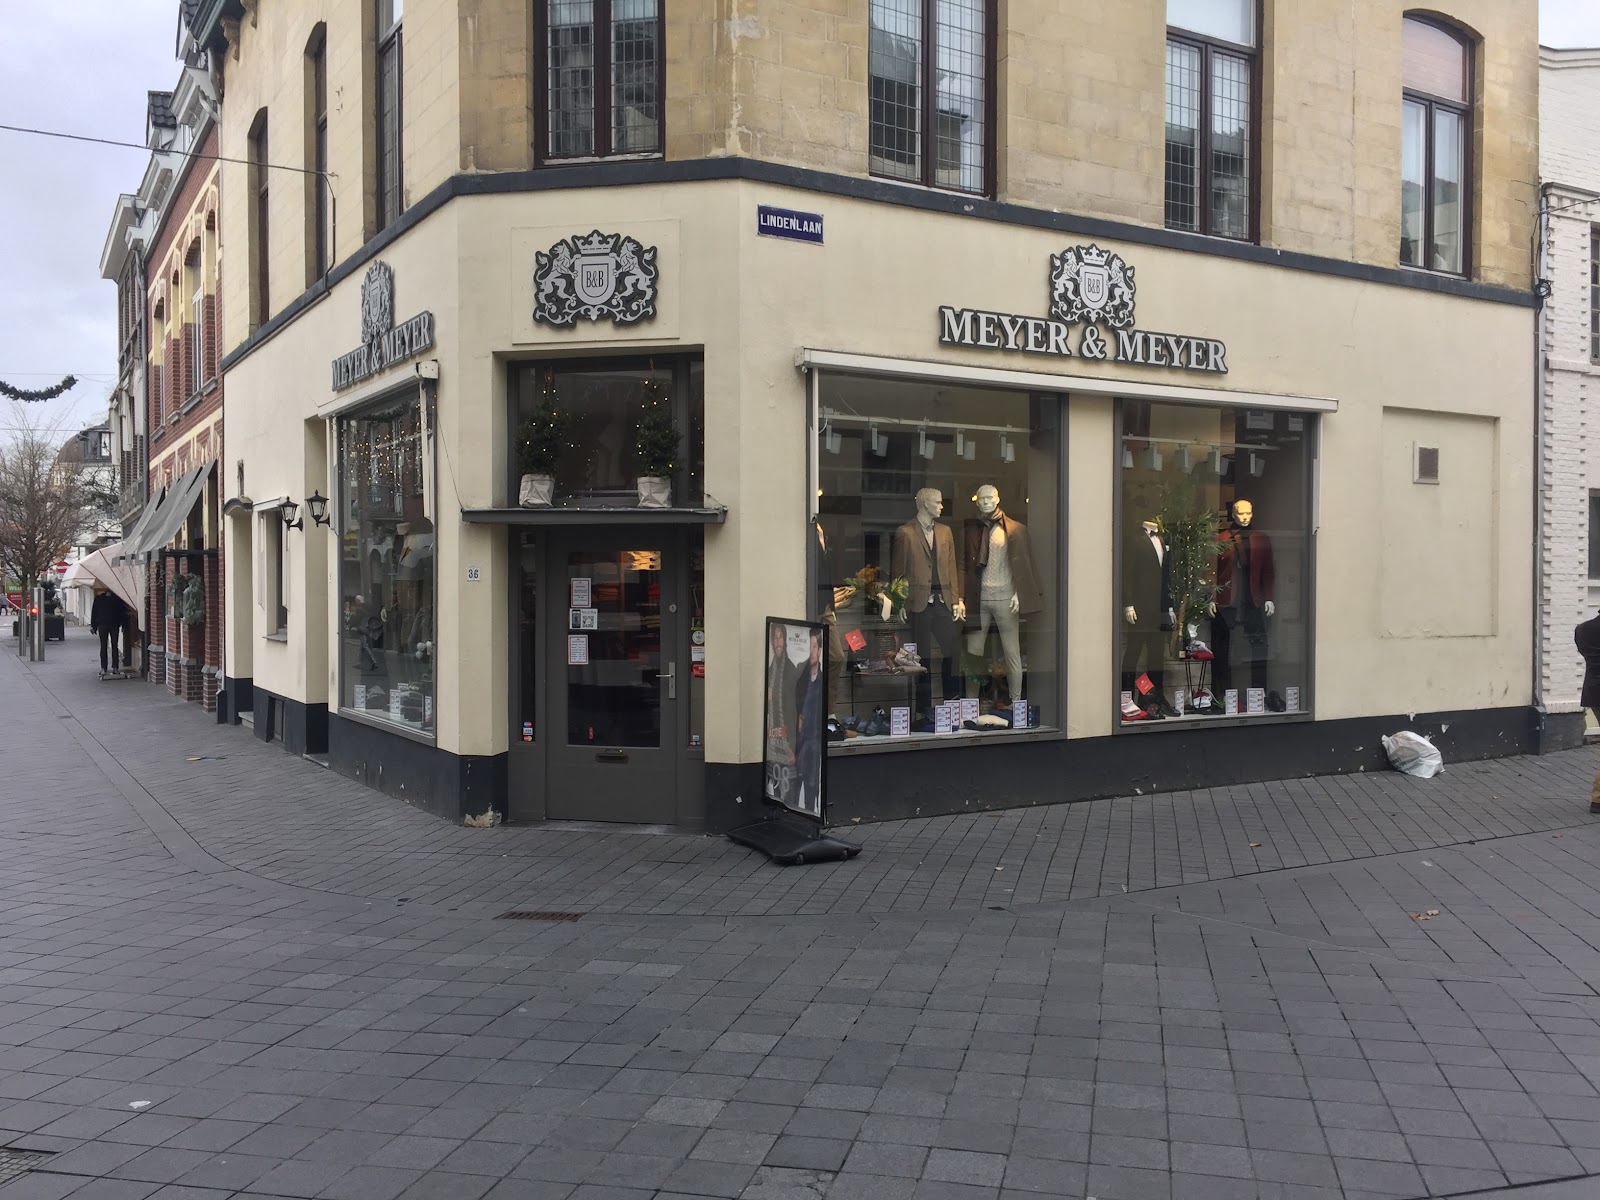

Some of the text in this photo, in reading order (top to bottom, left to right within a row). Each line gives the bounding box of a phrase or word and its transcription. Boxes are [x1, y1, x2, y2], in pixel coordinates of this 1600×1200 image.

[760, 213, 822, 235] LINDENLAAN
[586, 270, 604, 288] B&B
[1087, 277, 1101, 295] B&B
[332, 313, 431, 388] MEYER & MEYER
[941, 308, 1228, 373] MEYER & MEYER
[468, 568, 479, 579] 36
